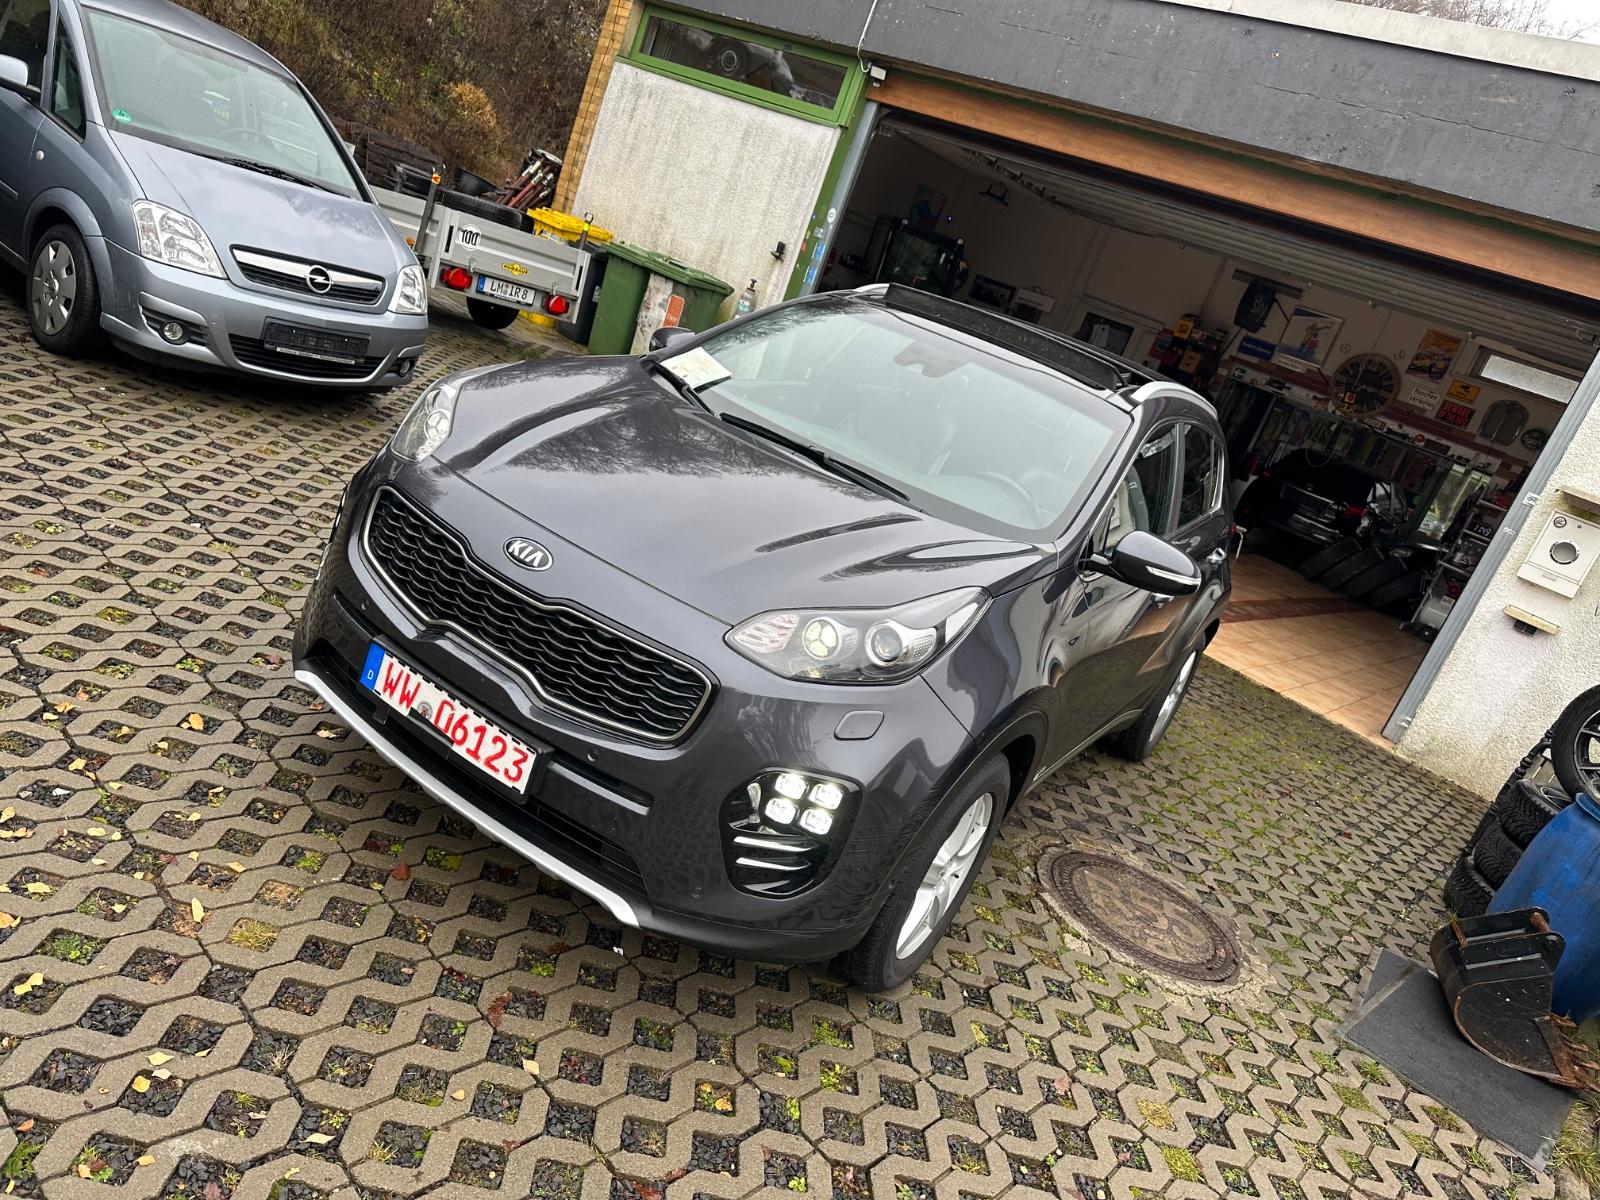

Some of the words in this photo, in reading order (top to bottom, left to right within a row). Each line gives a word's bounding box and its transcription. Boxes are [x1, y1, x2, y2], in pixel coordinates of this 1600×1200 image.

[460, 229, 480, 246] 100
[490, 280, 504, 294] LM
[521, 289, 528, 300] 8
[508, 540, 543, 567] KIA
[367, 669, 373, 680] D
[382, 661, 422, 709] WW
[433, 699, 529, 783] 06123
